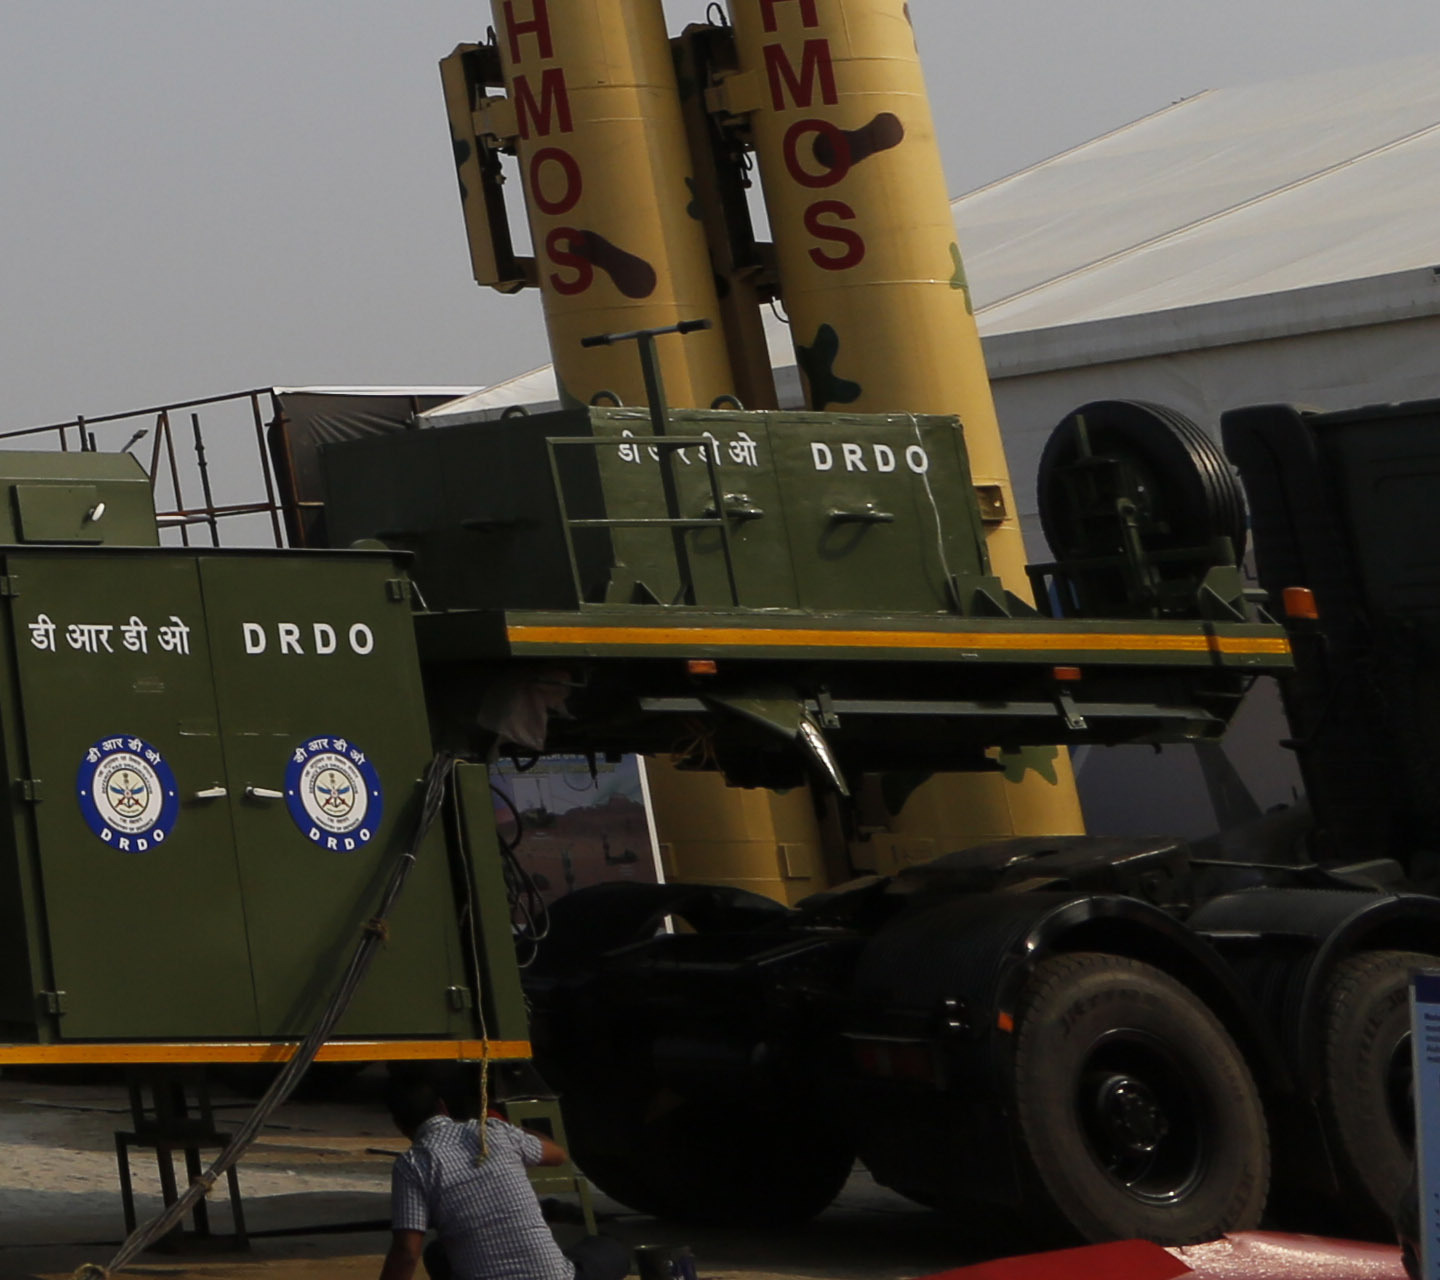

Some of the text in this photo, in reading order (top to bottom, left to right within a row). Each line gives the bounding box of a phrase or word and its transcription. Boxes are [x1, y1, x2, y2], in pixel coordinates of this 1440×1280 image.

[728, 432, 759, 467] ओ
[811, 442, 929, 474] DRDO
[29, 614, 191, 655] डी आर डी ओ
[242, 622, 374, 655] DRDO
[100, 827, 164, 851] DRDO
[309, 827, 371, 850] DRDO
